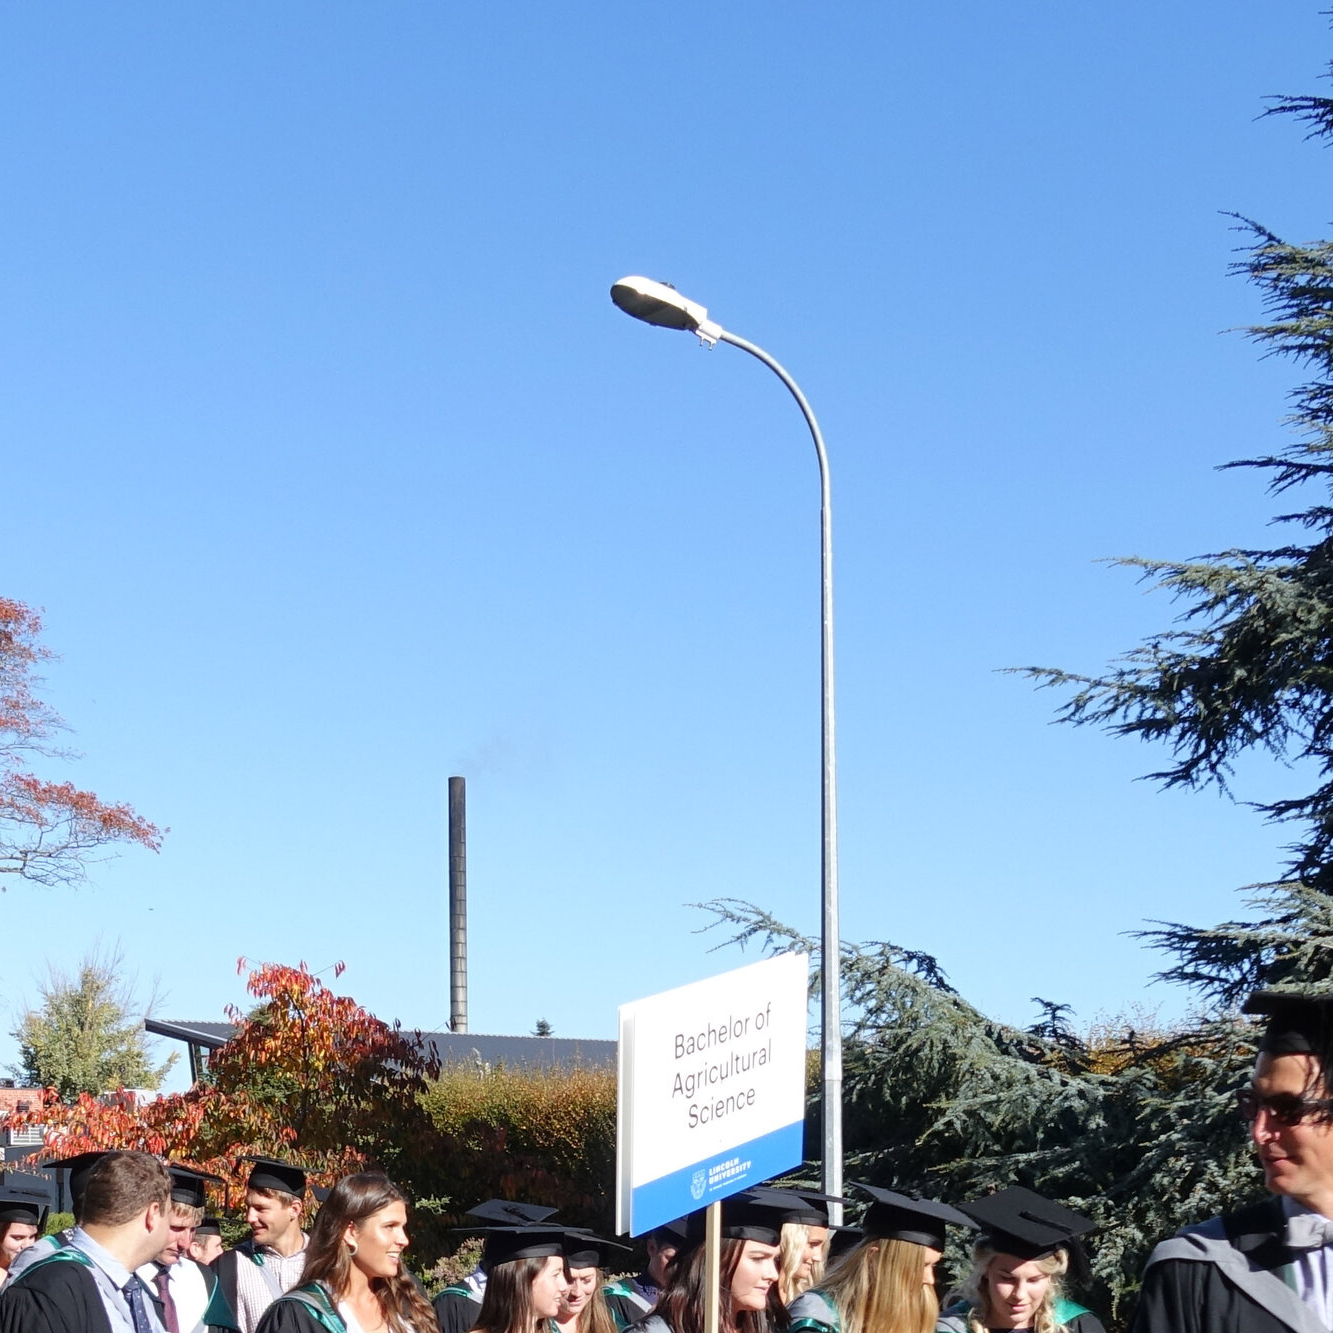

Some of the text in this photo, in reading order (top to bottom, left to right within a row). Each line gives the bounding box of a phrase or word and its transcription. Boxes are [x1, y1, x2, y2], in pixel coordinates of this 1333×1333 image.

[674, 1001, 771, 1060] Bachelor of
[672, 1038, 772, 1099] Agricultural
[688, 1088, 756, 1129] Science
[708, 1157, 740, 1177] LINCOLN
[708, 1160, 752, 1185] UNIVERSITY
